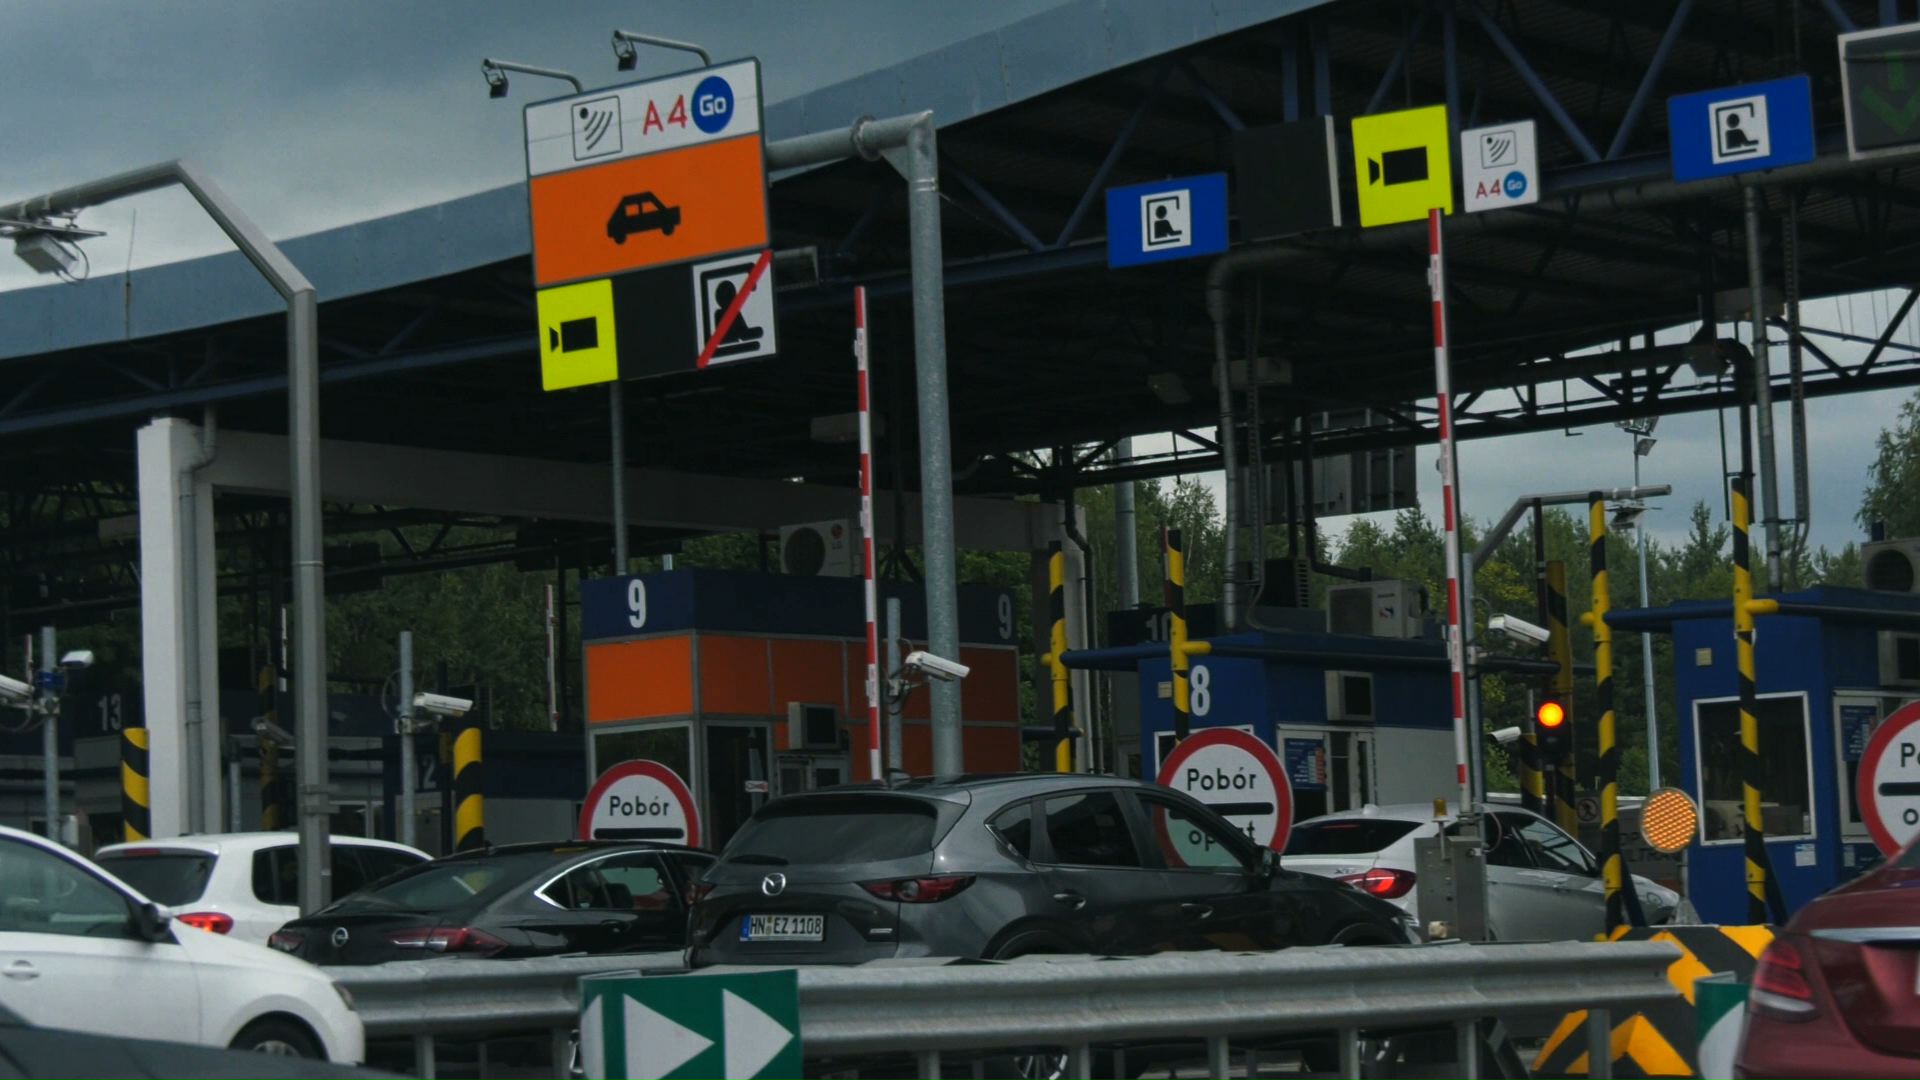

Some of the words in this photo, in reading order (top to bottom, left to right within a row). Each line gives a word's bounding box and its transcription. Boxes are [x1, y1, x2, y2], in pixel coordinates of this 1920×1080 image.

[643, 94, 688, 135] A4
[699, 94, 727, 117] Go
[1475, 179, 1501, 199] A4
[628, 578, 647, 628] 9
[998, 594, 1012, 639] 9
[1190, 664, 1211, 717] 8
[99, 693, 122, 731] 13
[1187, 767, 1257, 791] Pobór
[609, 795, 669, 817] Pobór
[750, 916, 766, 935] HN
[773, 916, 789, 934] EZ
[791, 916, 822, 935] 1108
